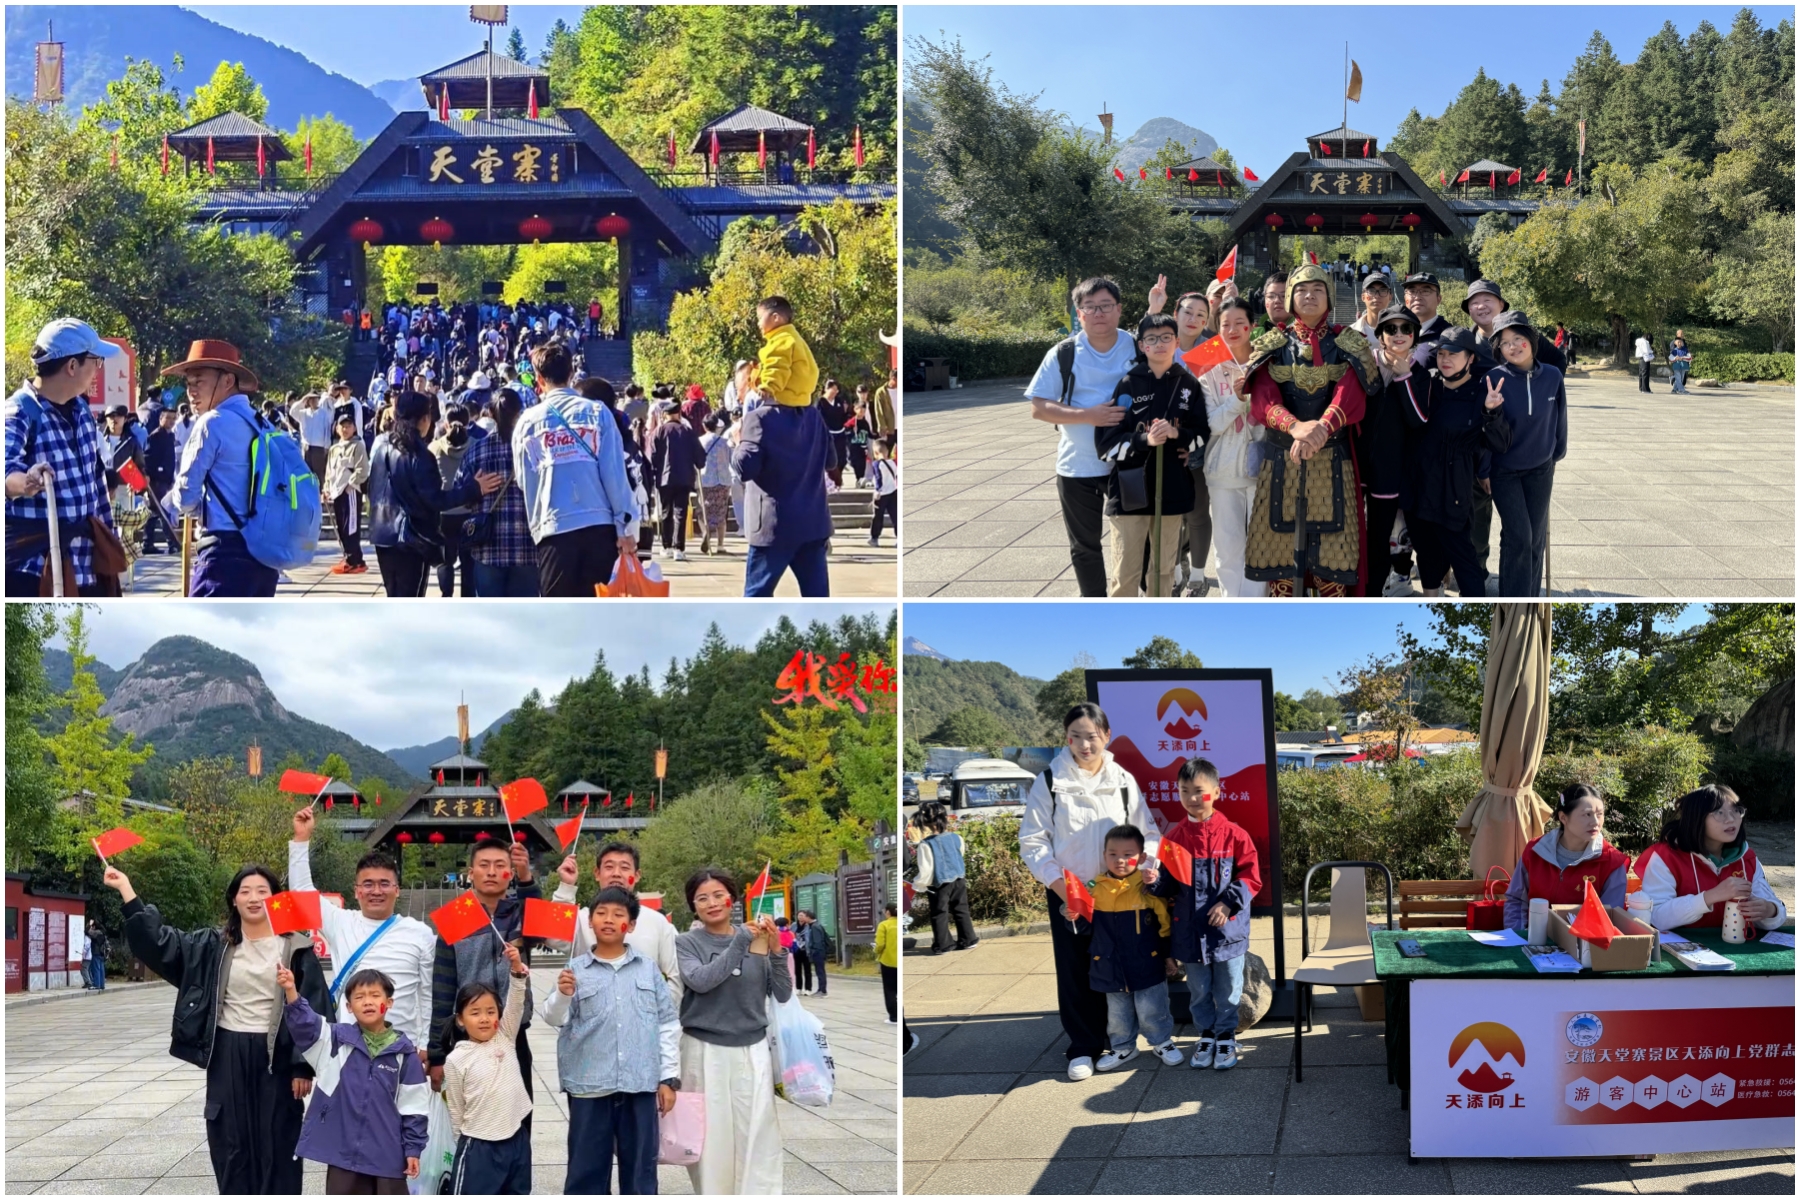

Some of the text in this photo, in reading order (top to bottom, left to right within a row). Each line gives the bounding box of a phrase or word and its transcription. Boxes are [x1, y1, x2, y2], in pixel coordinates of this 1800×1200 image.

[429, 144, 542, 184] 天堂寨
[1309, 172, 1373, 195] 天堂寨
[1157, 740, 1211, 752] 天添向上
[433, 798, 487, 817] 天堂寨
[1445, 1093, 1526, 1109] 天添向上
[1574, 1082, 1727, 1102] 游客中心站
